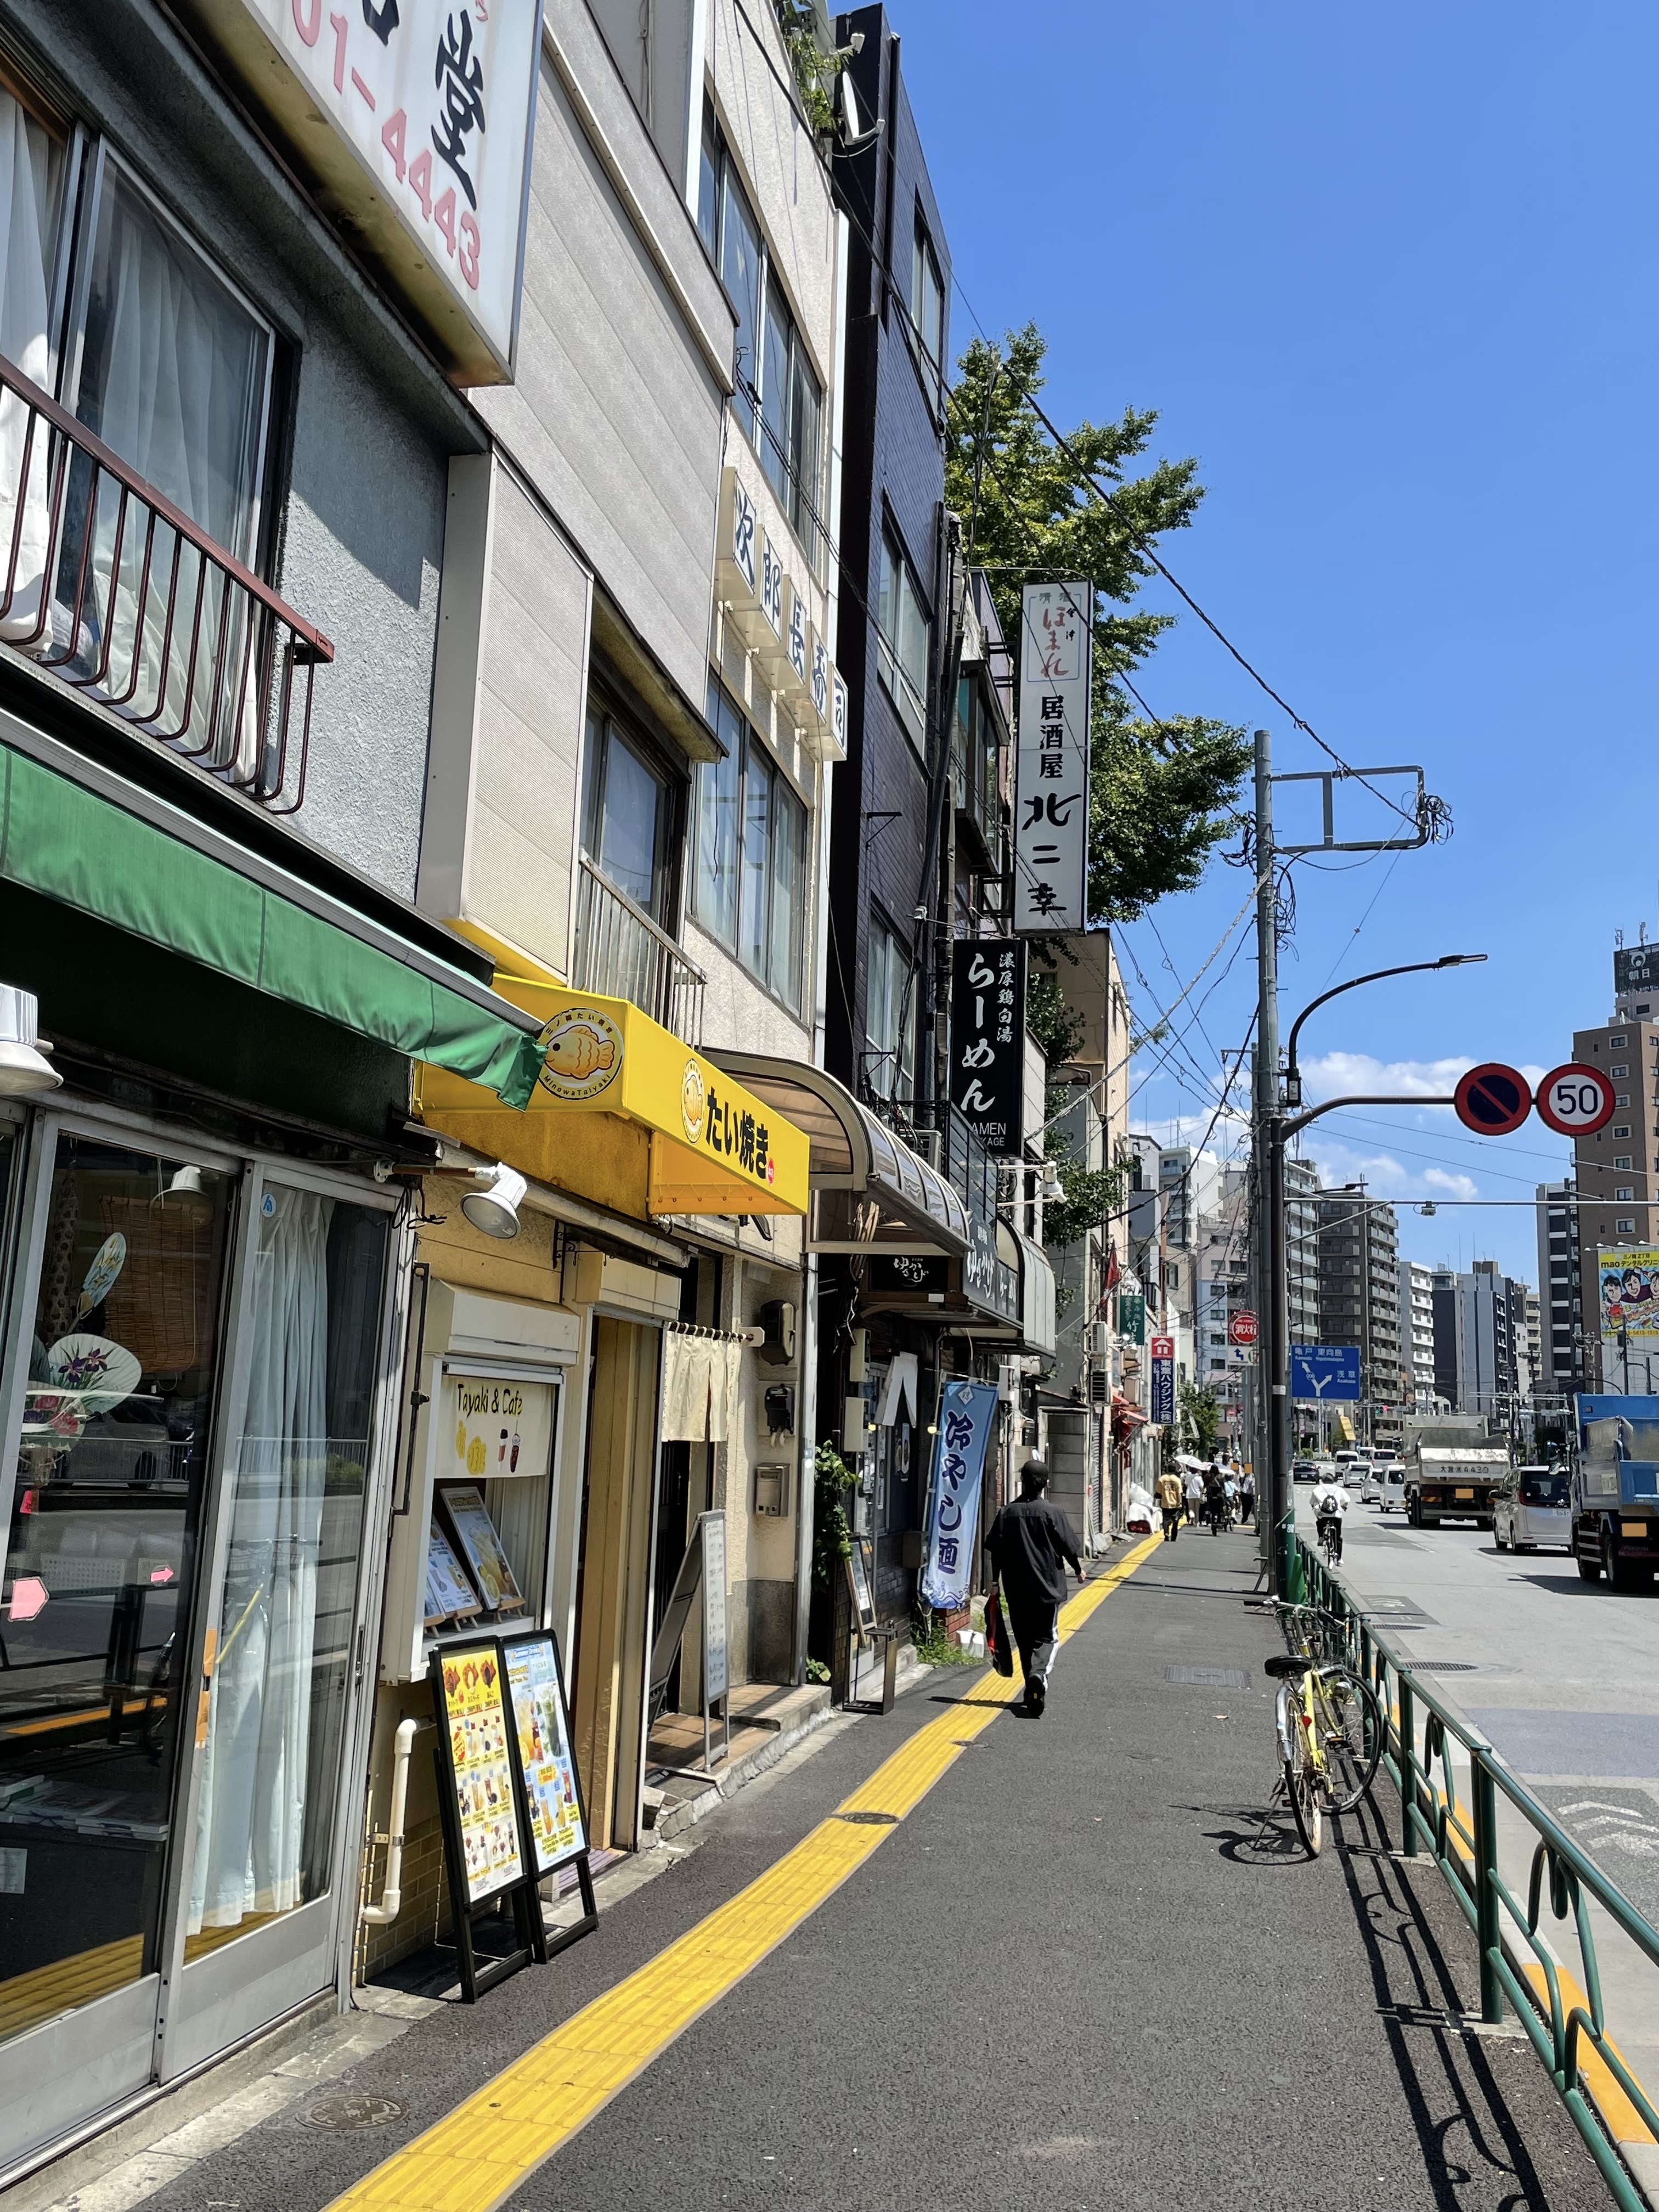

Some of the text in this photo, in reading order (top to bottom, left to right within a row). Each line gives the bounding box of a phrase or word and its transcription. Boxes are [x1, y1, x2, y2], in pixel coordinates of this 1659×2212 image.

[1041, 606, 1069, 678] ほまれ
[1022, 695, 1082, 916] 居酒屋 北二幸
[961, 953, 996, 1112] らーめん
[996, 951, 1015, 1043] 濃厚鶏白湯
[706, 1086, 769, 1180] たい焼き
[972, 1122, 1007, 1136] AMEN
[1557, 1085, 1598, 1115] 50
[893, 1256, 929, 1283] ゆきかげ
[458, 1384, 522, 1418] Tayaki & Cafe
